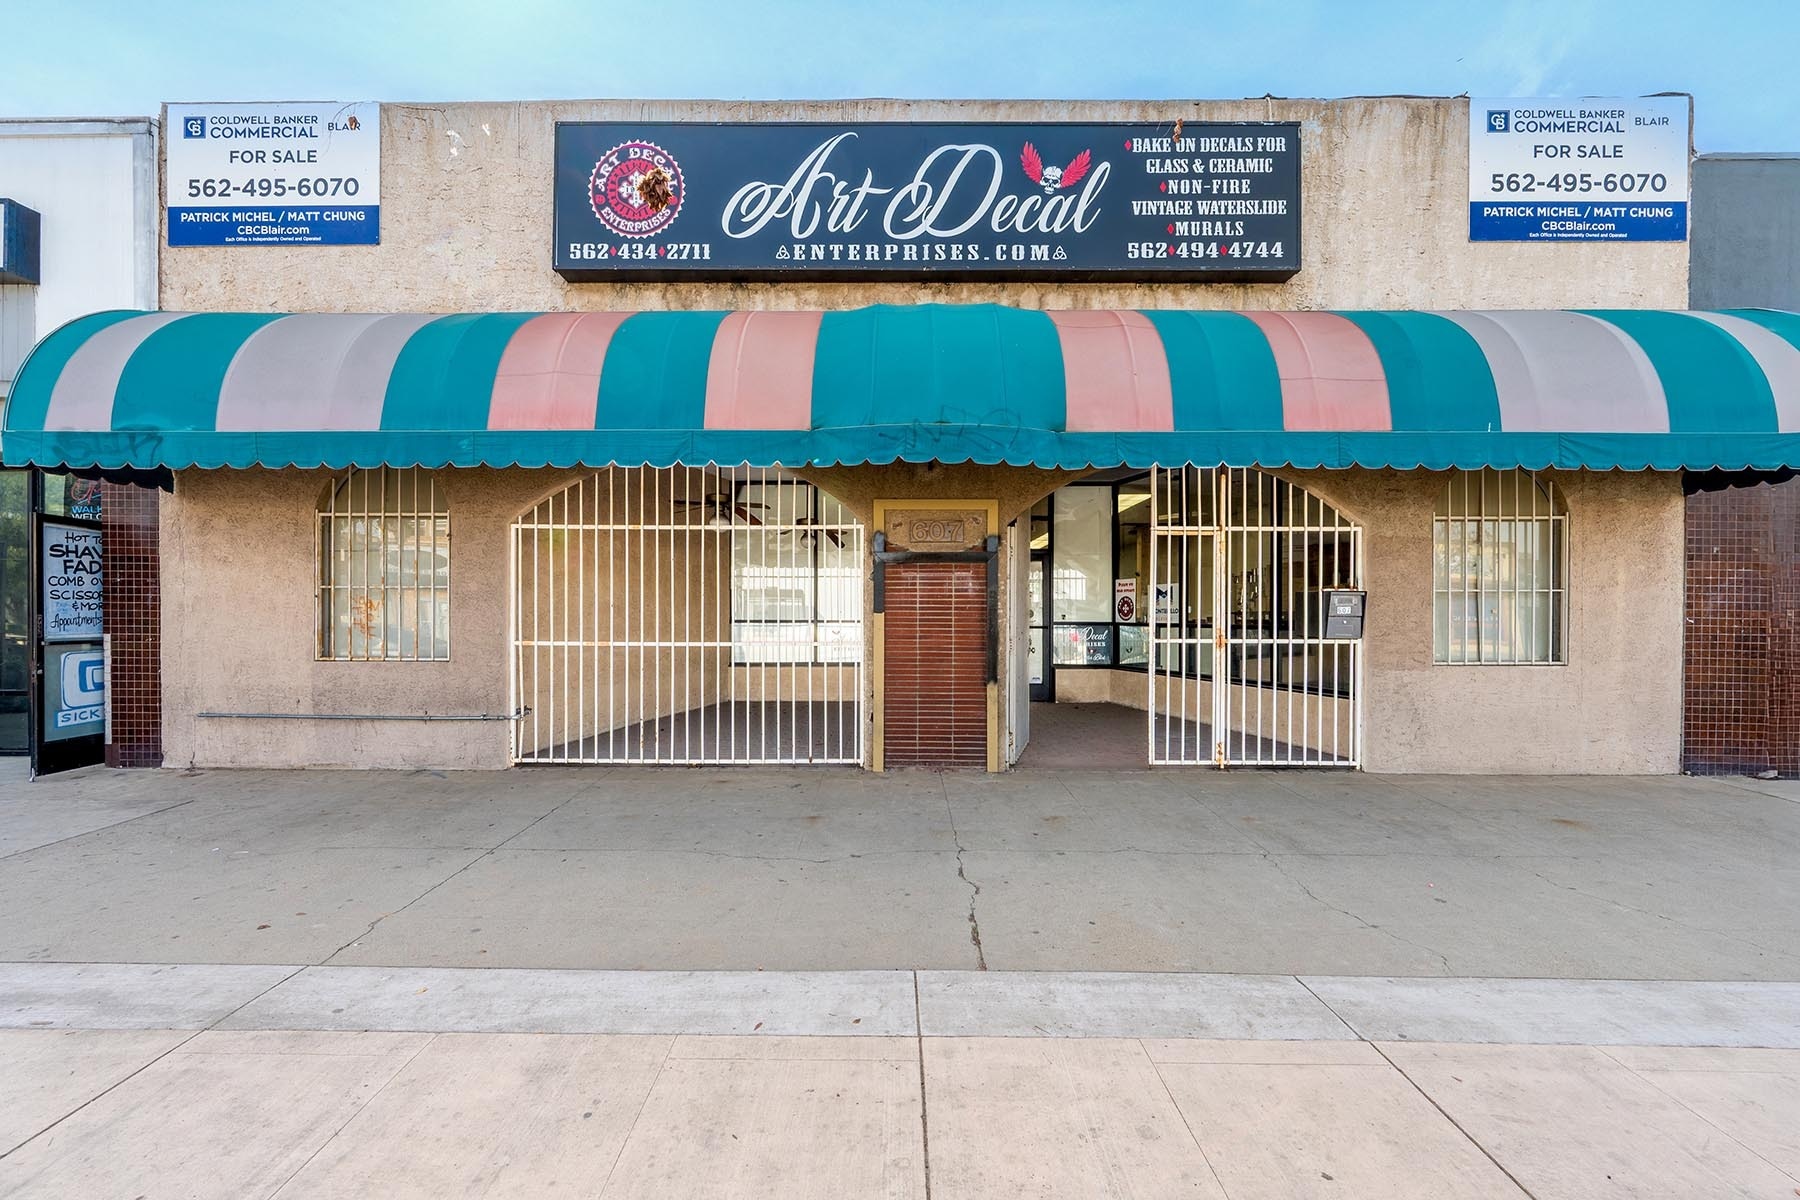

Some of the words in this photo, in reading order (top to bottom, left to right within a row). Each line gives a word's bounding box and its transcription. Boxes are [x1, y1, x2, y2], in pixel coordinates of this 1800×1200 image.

[210, 116, 270, 124] COLDWELL
[274, 116, 318, 124] BANKER
[1514, 110, 1576, 119] COLDWELL
[1580, 110, 1625, 119] BANKER
[1634, 116, 1669, 126] BLAIR
[210, 126, 318, 138] COMMERCIAL
[1514, 121, 1625, 133] COMMERCIAL
[1132, 138, 1171, 152] BAKE
[1176, 138, 1196, 152] ON
[1200, 138, 1254, 152] DECALS
[1257, 137, 1286, 152] FOR
[1533, 145, 1570, 158] FOR
[1577, 145, 1624, 158] SALE
[230, 150, 266, 164] FOR
[272, 150, 318, 163] SALE
[595, 152, 620, 192] ART
[1146, 158, 1189, 174] GLASS
[1192, 158, 1205, 174] &
[1209, 158, 1273, 173] CERAMIC
[188, 177, 360, 198] 562-495-6070
[721, 131, 894, 239] Art
[882, 143, 1111, 240] Decal
[1168, 179, 1251, 194] NON-FIRE
[1490, 173, 1667, 193] 562-495-6070
[1132, 200, 1192, 216] VINTAGE
[1196, 200, 1287, 215] WATERSLIDE
[1483, 206, 1534, 217] PATRICK
[1536, 206, 1582, 217] MICHEL
[1584, 206, 1591, 218] /
[1593, 207, 1626, 217] MATT
[1630, 206, 1674, 217] CHUNG
[180, 212, 230, 222] PATRICK
[232, 212, 276, 222] MICHEL
[278, 210, 286, 224] /
[288, 212, 320, 222] MATT
[323, 210, 366, 222] CHUNG
[600, 206, 671, 232] ENTERPRISES
[237, 225, 310, 235] CBCBlair.com
[1175, 221, 1244, 236] MURALS
[1541, 221, 1616, 230] CBCBlair.com
[792, 243, 1051, 262] ENTERPRISES.COM
[65, 531, 90, 544] HOT
[913, 522, 961, 541] 607
[63, 560, 102, 575] FAD
[48, 576, 85, 586] COMB
[62, 709, 100, 723] SICK
